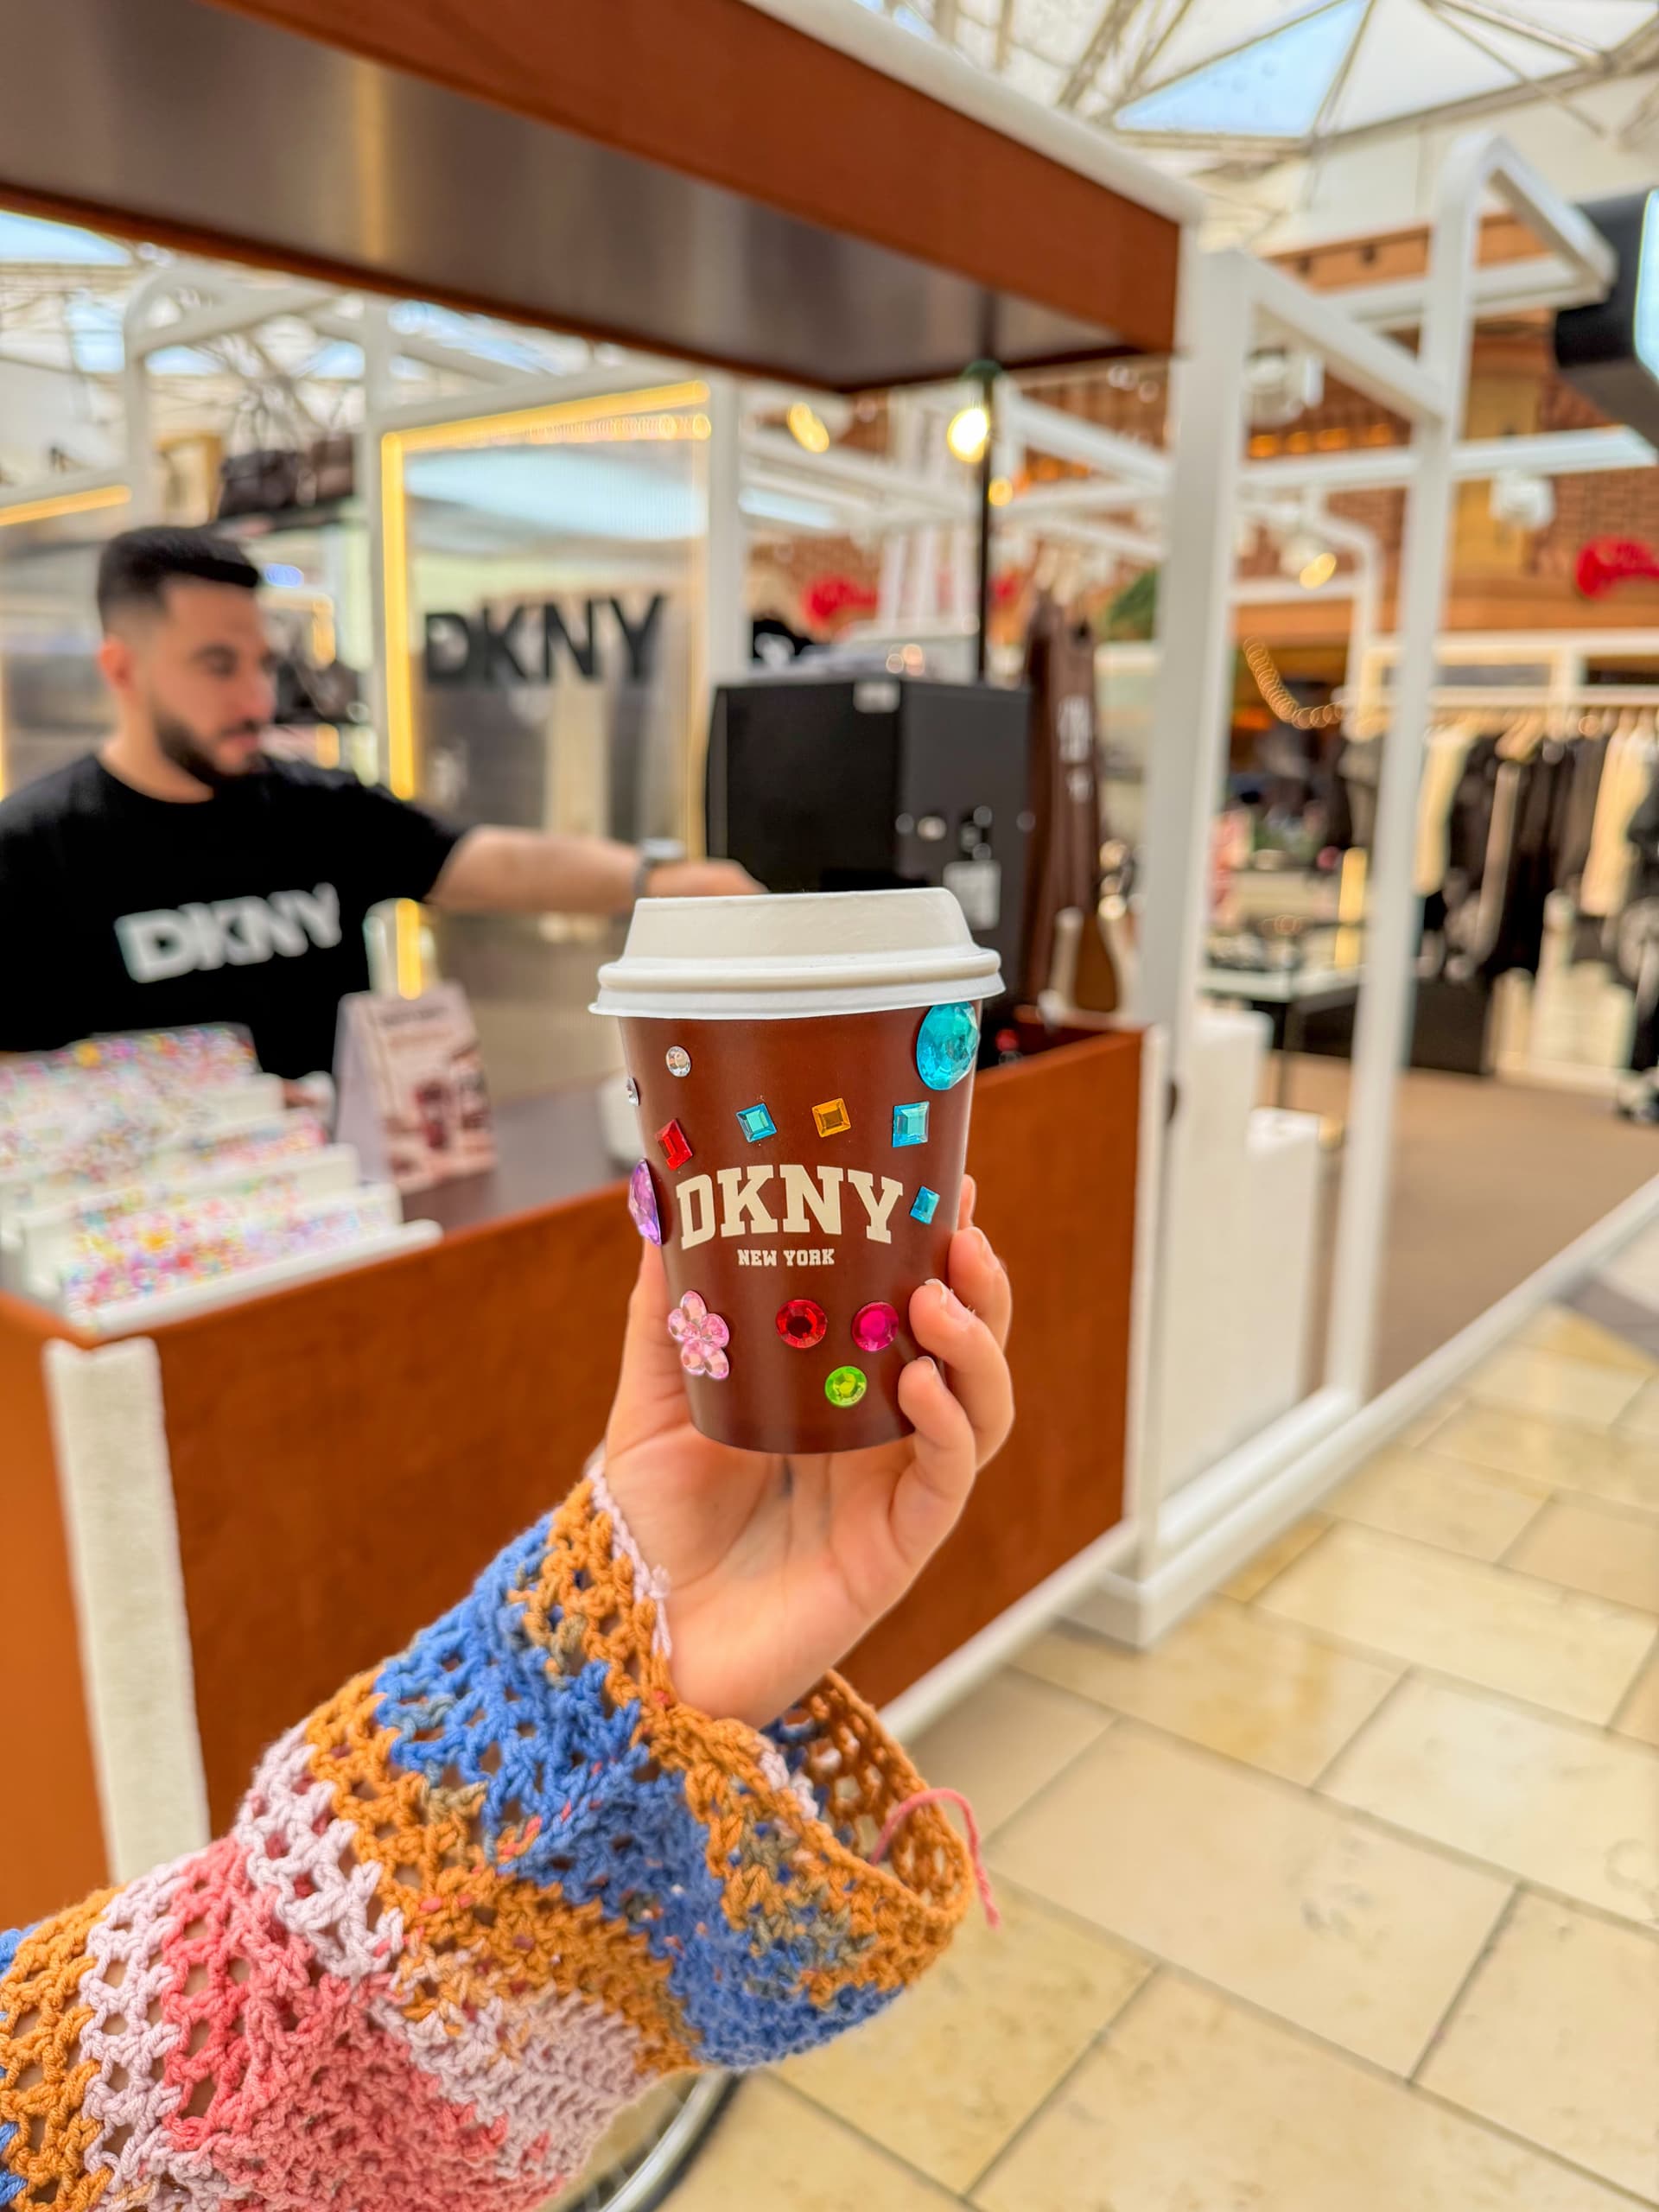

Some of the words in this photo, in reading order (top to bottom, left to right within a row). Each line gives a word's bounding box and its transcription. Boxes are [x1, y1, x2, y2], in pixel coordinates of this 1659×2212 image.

[423, 591, 667, 683] DKNY
[114, 882, 342, 983] DKNY
[676, 1164, 904, 1250] DKNY
[737, 1249, 777, 1267] NEW
[783, 1249, 835, 1267] YORK
